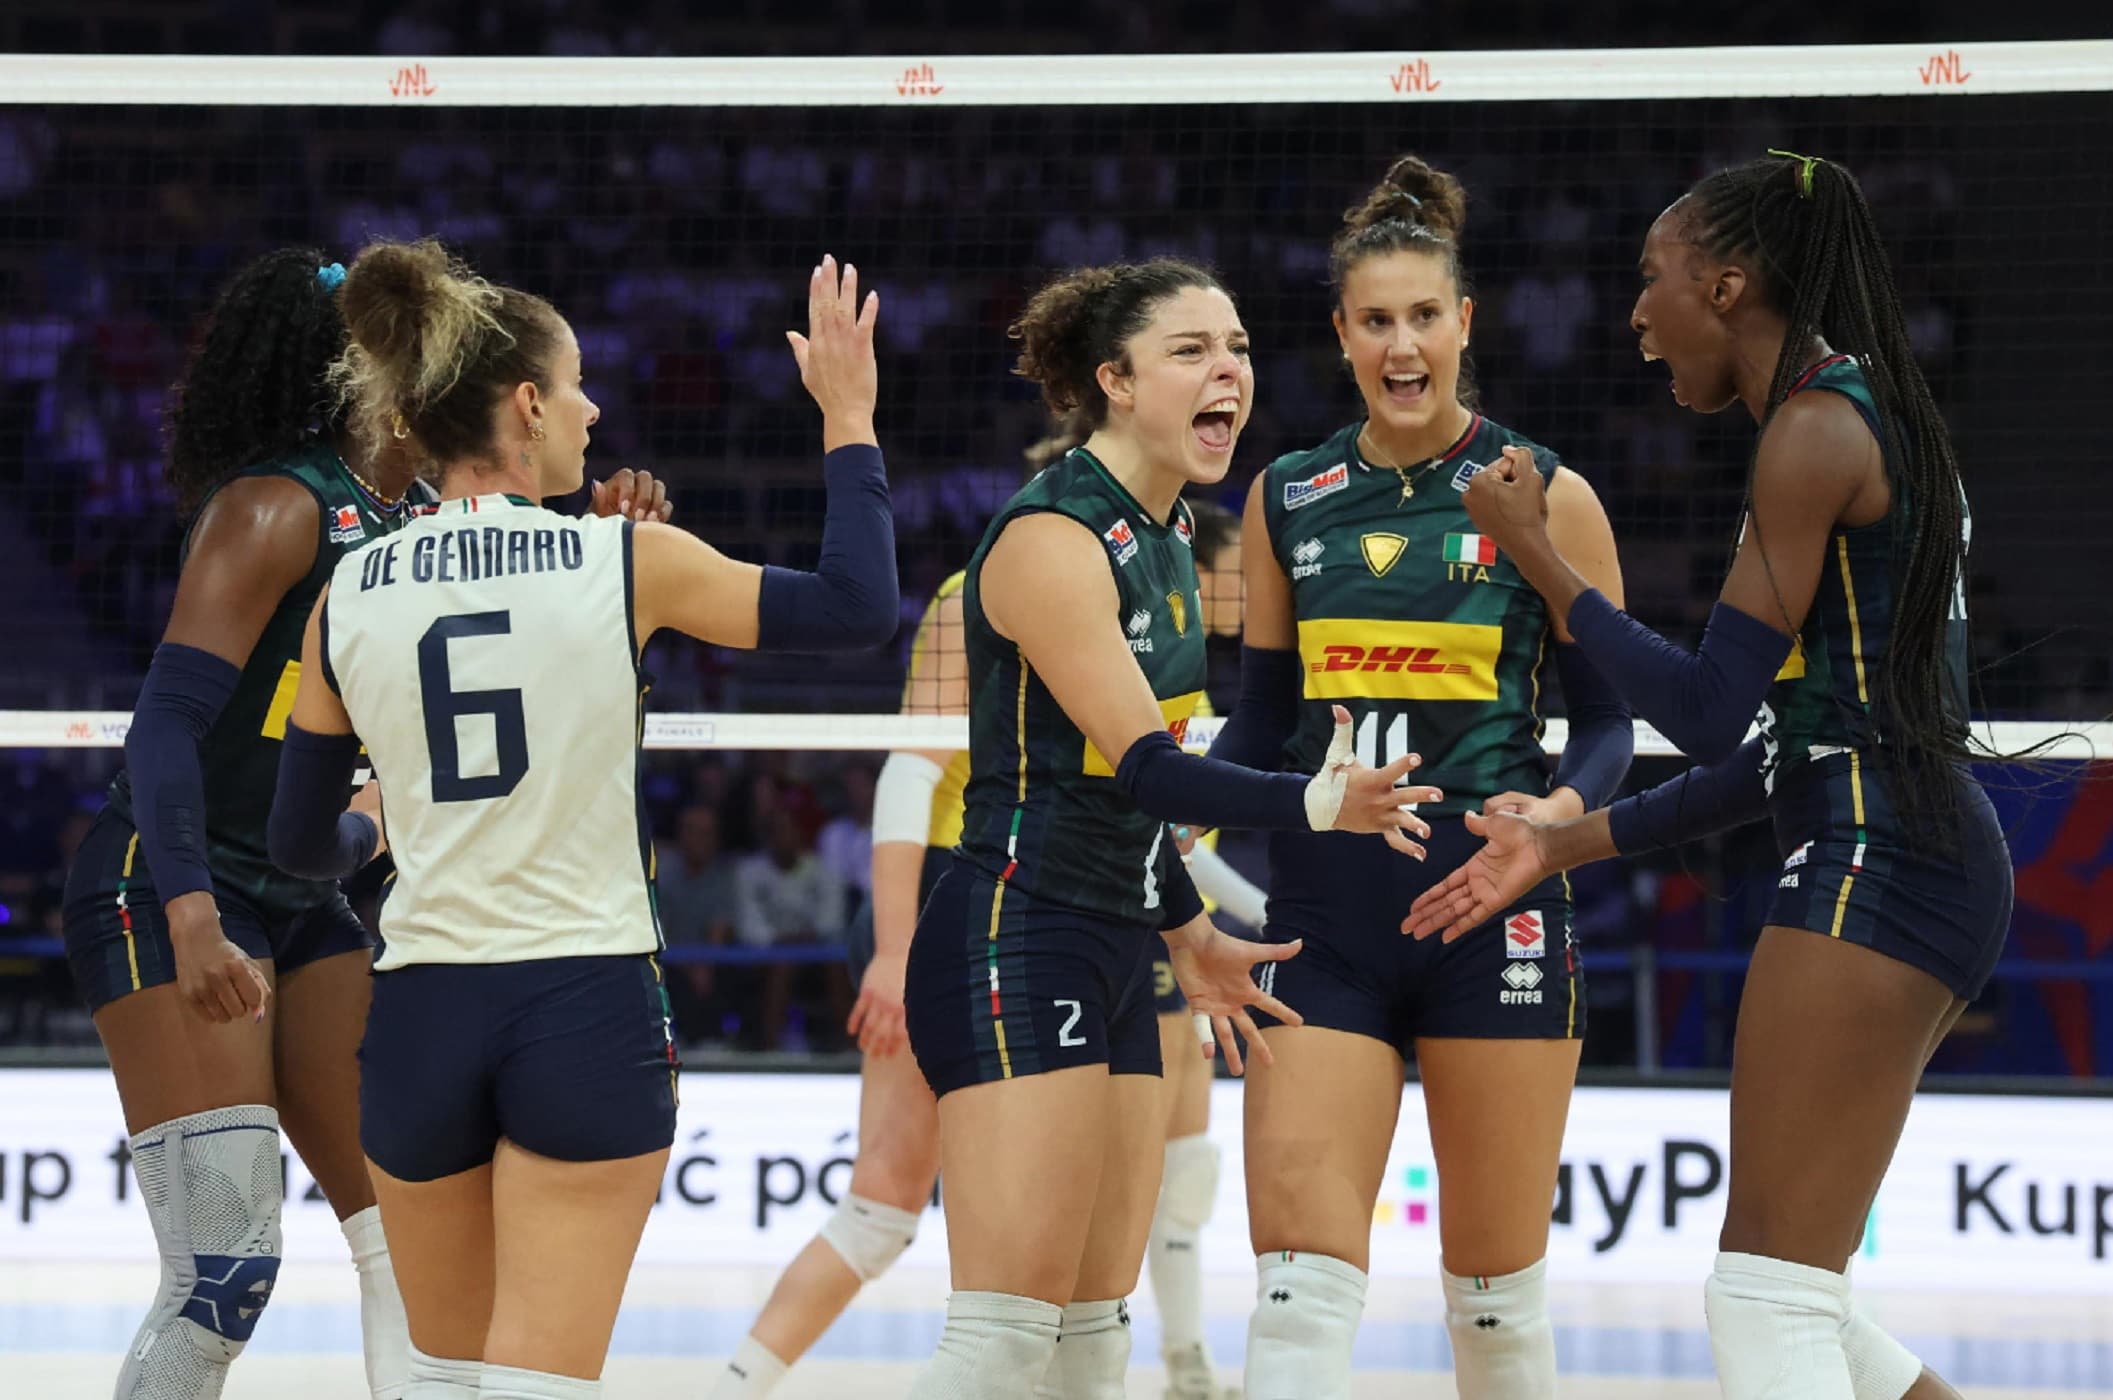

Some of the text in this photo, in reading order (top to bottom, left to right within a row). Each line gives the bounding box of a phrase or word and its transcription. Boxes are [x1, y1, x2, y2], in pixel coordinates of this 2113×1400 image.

[388, 63, 438, 96] VNL
[896, 63, 944, 96] VNL
[1389, 58, 1442, 92] VNL
[1919, 49, 1972, 85] VNL
[360, 527, 583, 592] DE GENNARO
[1448, 563, 1490, 583] ITA
[1324, 645, 1440, 674] DHL
[417, 609, 529, 803] 6
[1506, 949, 1544, 958] SUZUKI
[1053, 1000, 1087, 1047] 2
